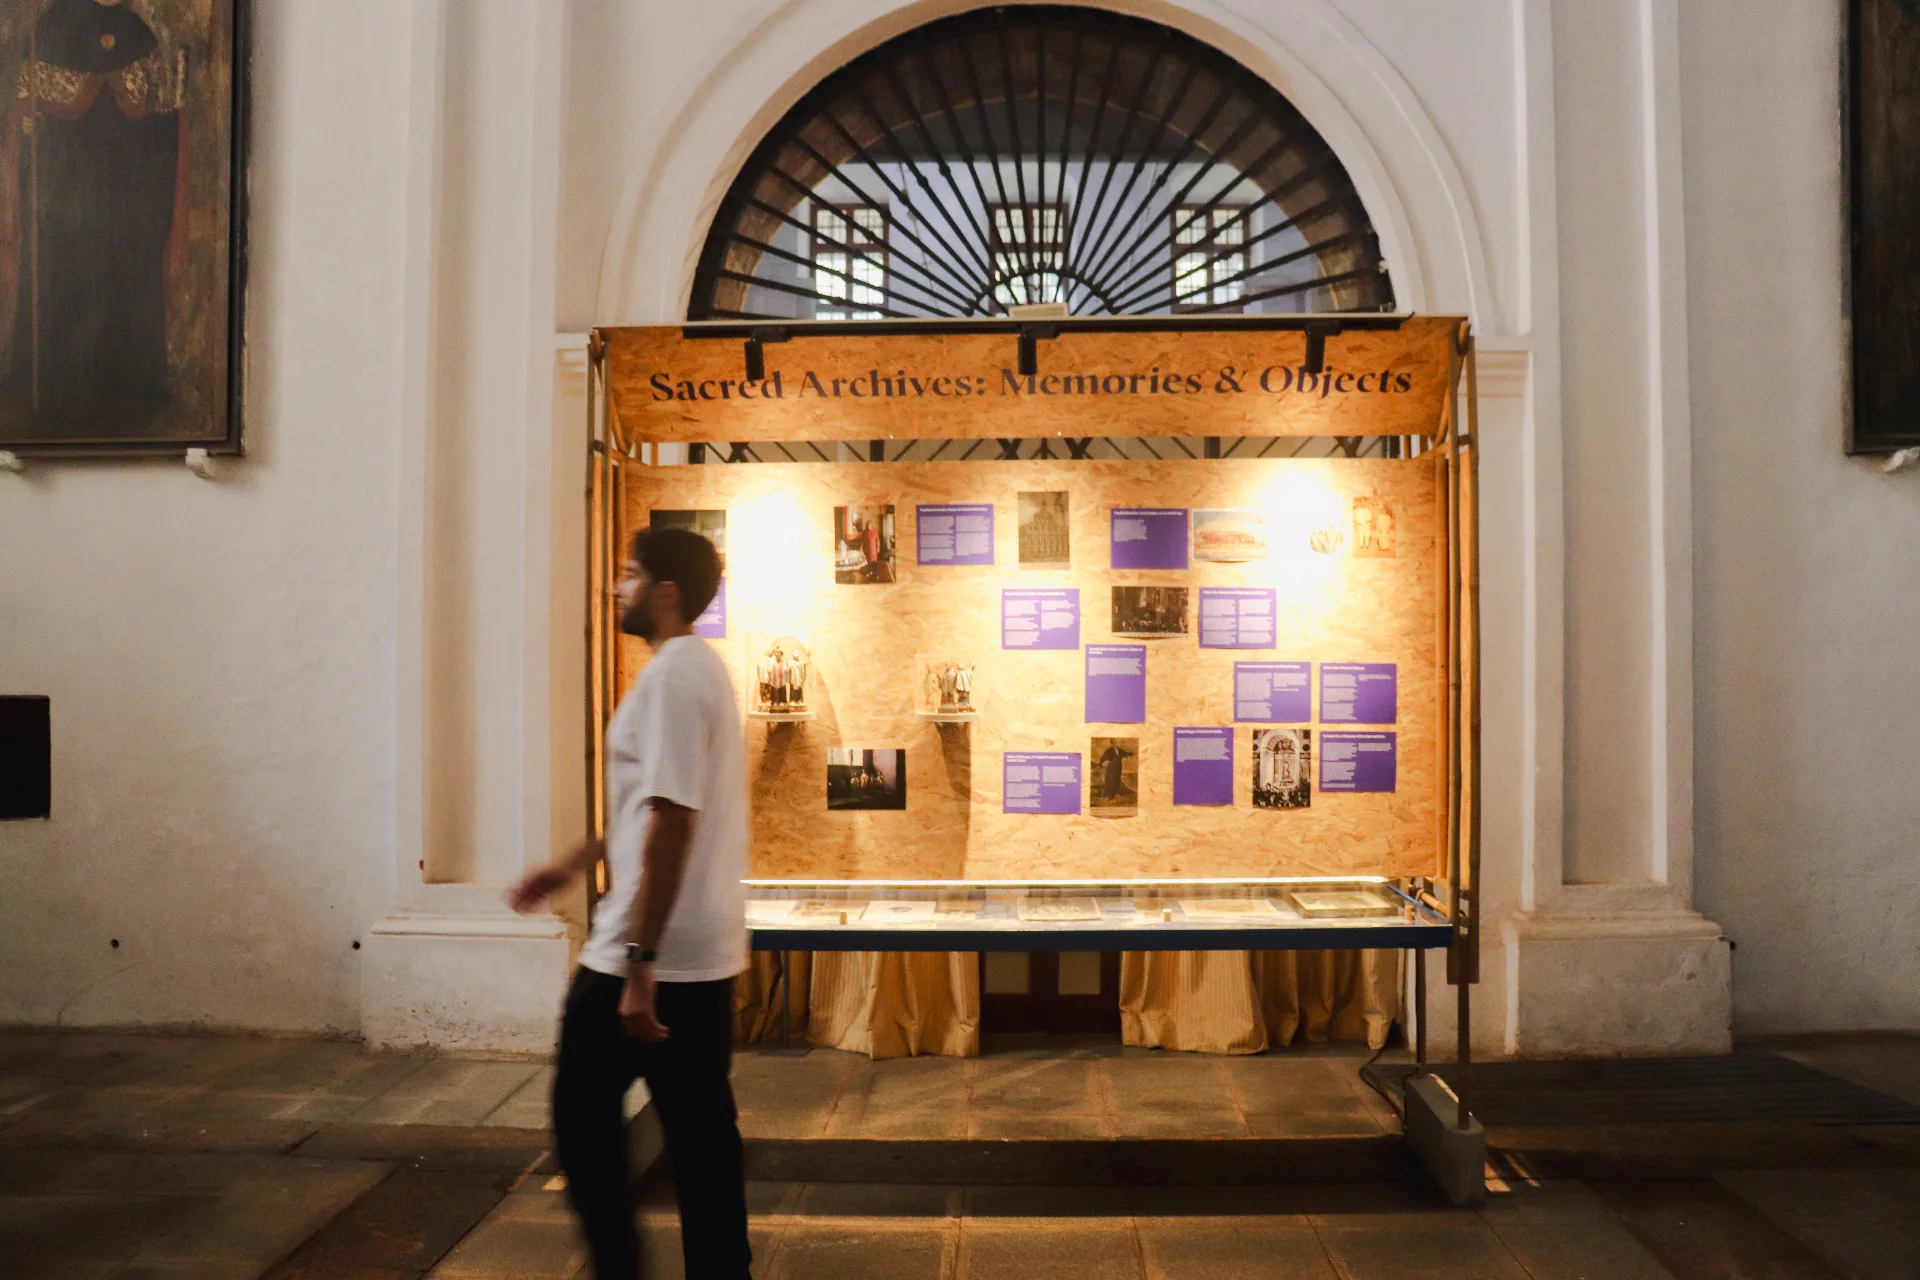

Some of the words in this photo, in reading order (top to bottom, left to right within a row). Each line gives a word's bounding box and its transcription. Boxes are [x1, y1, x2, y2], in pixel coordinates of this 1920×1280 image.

[651, 370, 784, 401] Sacred
[799, 368, 986, 399] Archives:
[1000, 366, 1201, 396] Memories
[1214, 365, 1247, 395] &
[1259, 364, 1412, 400] Objects
